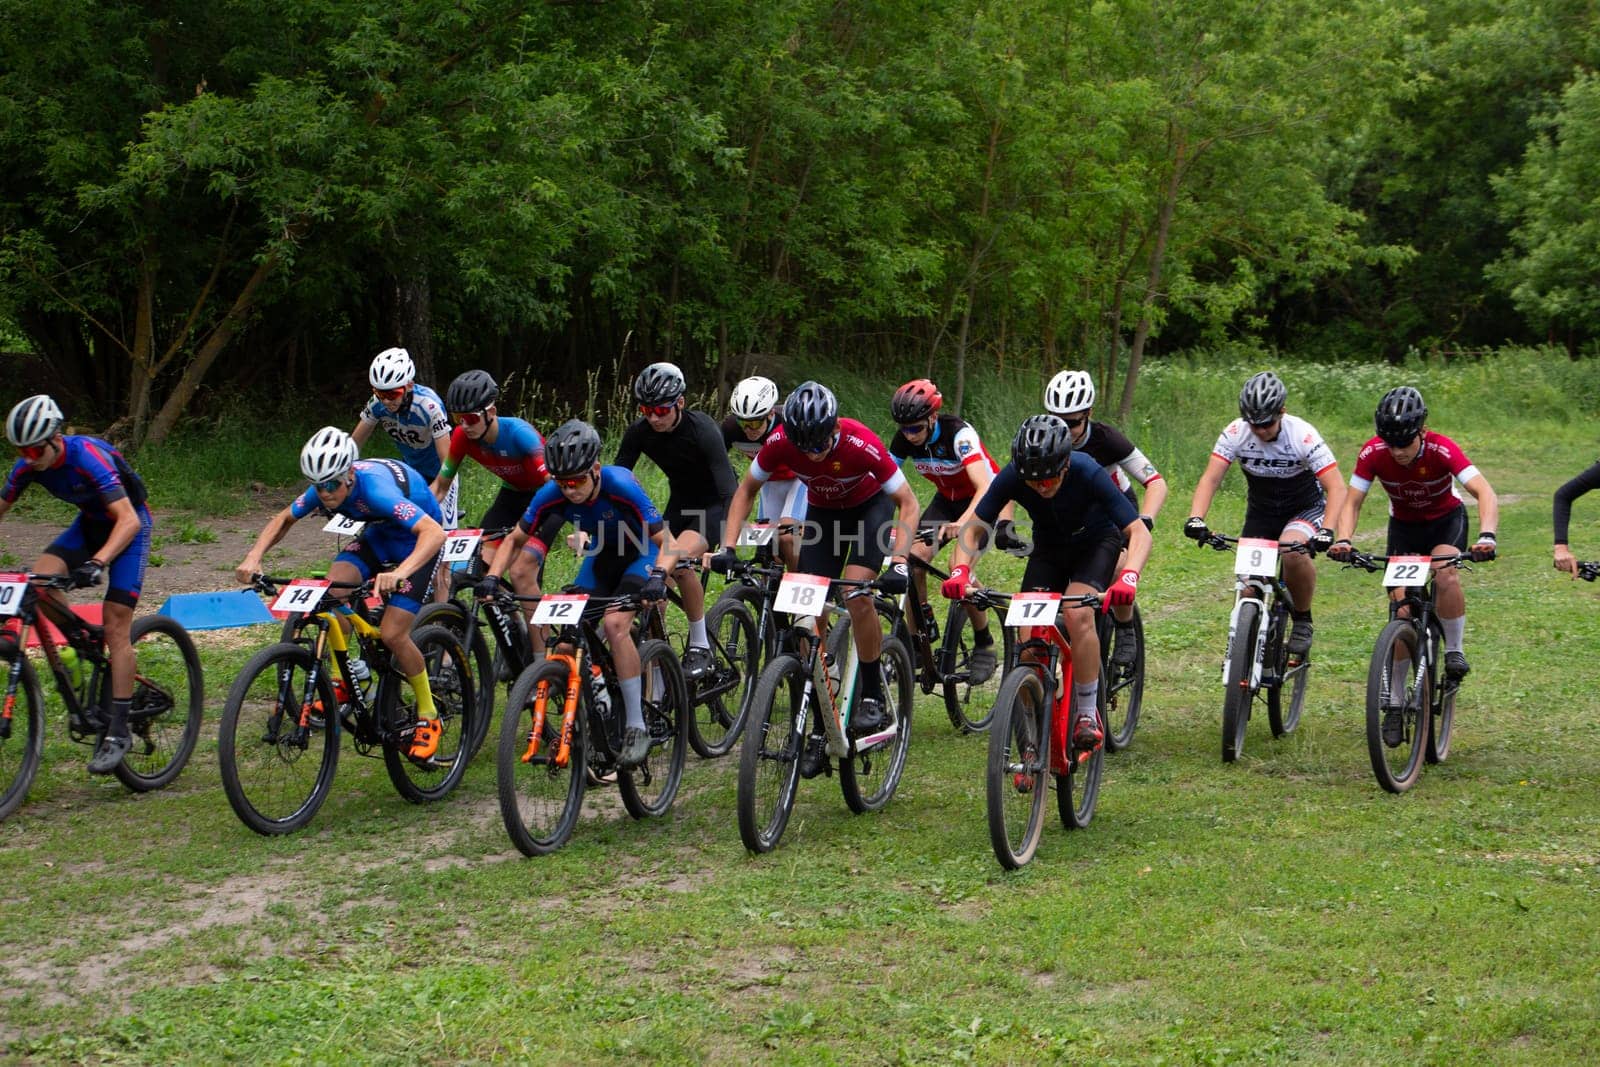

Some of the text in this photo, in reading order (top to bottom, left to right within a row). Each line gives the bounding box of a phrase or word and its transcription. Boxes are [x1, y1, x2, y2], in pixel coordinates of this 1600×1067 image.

[337, 517, 354, 529] 13
[448, 539, 469, 555] 15
[1251, 549, 1262, 568] 9
[1392, 564, 1420, 580] 22
[289, 588, 314, 605] 14
[790, 585, 816, 606] 18
[549, 602, 573, 618] 12
[1022, 602, 1048, 619] 17
